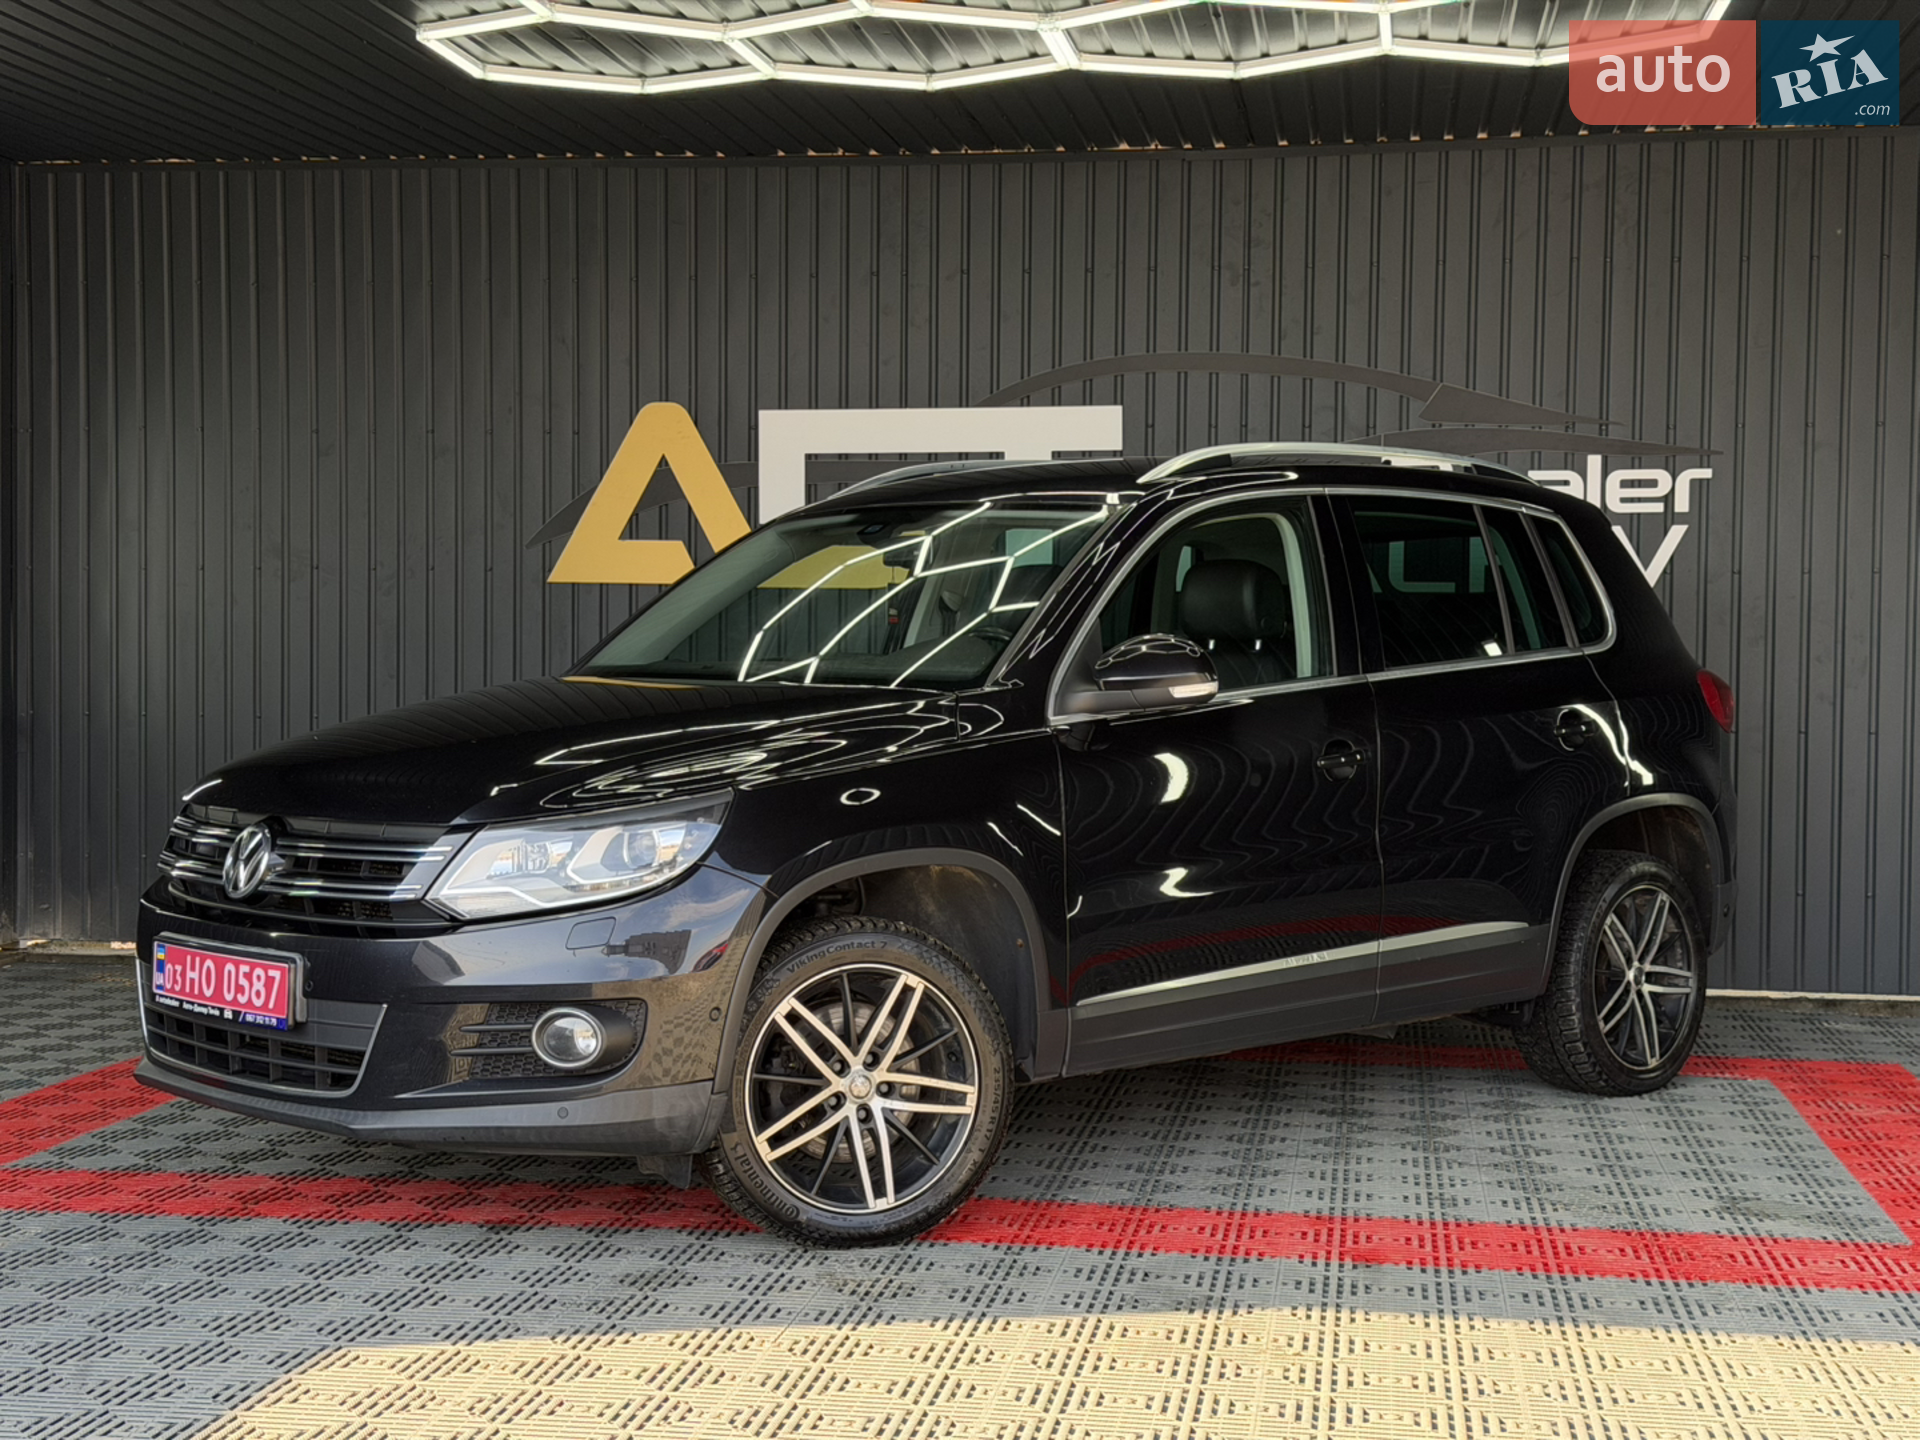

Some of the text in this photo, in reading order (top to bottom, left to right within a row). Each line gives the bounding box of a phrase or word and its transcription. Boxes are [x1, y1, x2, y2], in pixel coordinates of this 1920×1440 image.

[1527, 454, 1713, 513] aler
[165, 962, 183, 992] 03
[223, 962, 282, 1010] 0587
[734, 1152, 801, 1220] Continental
